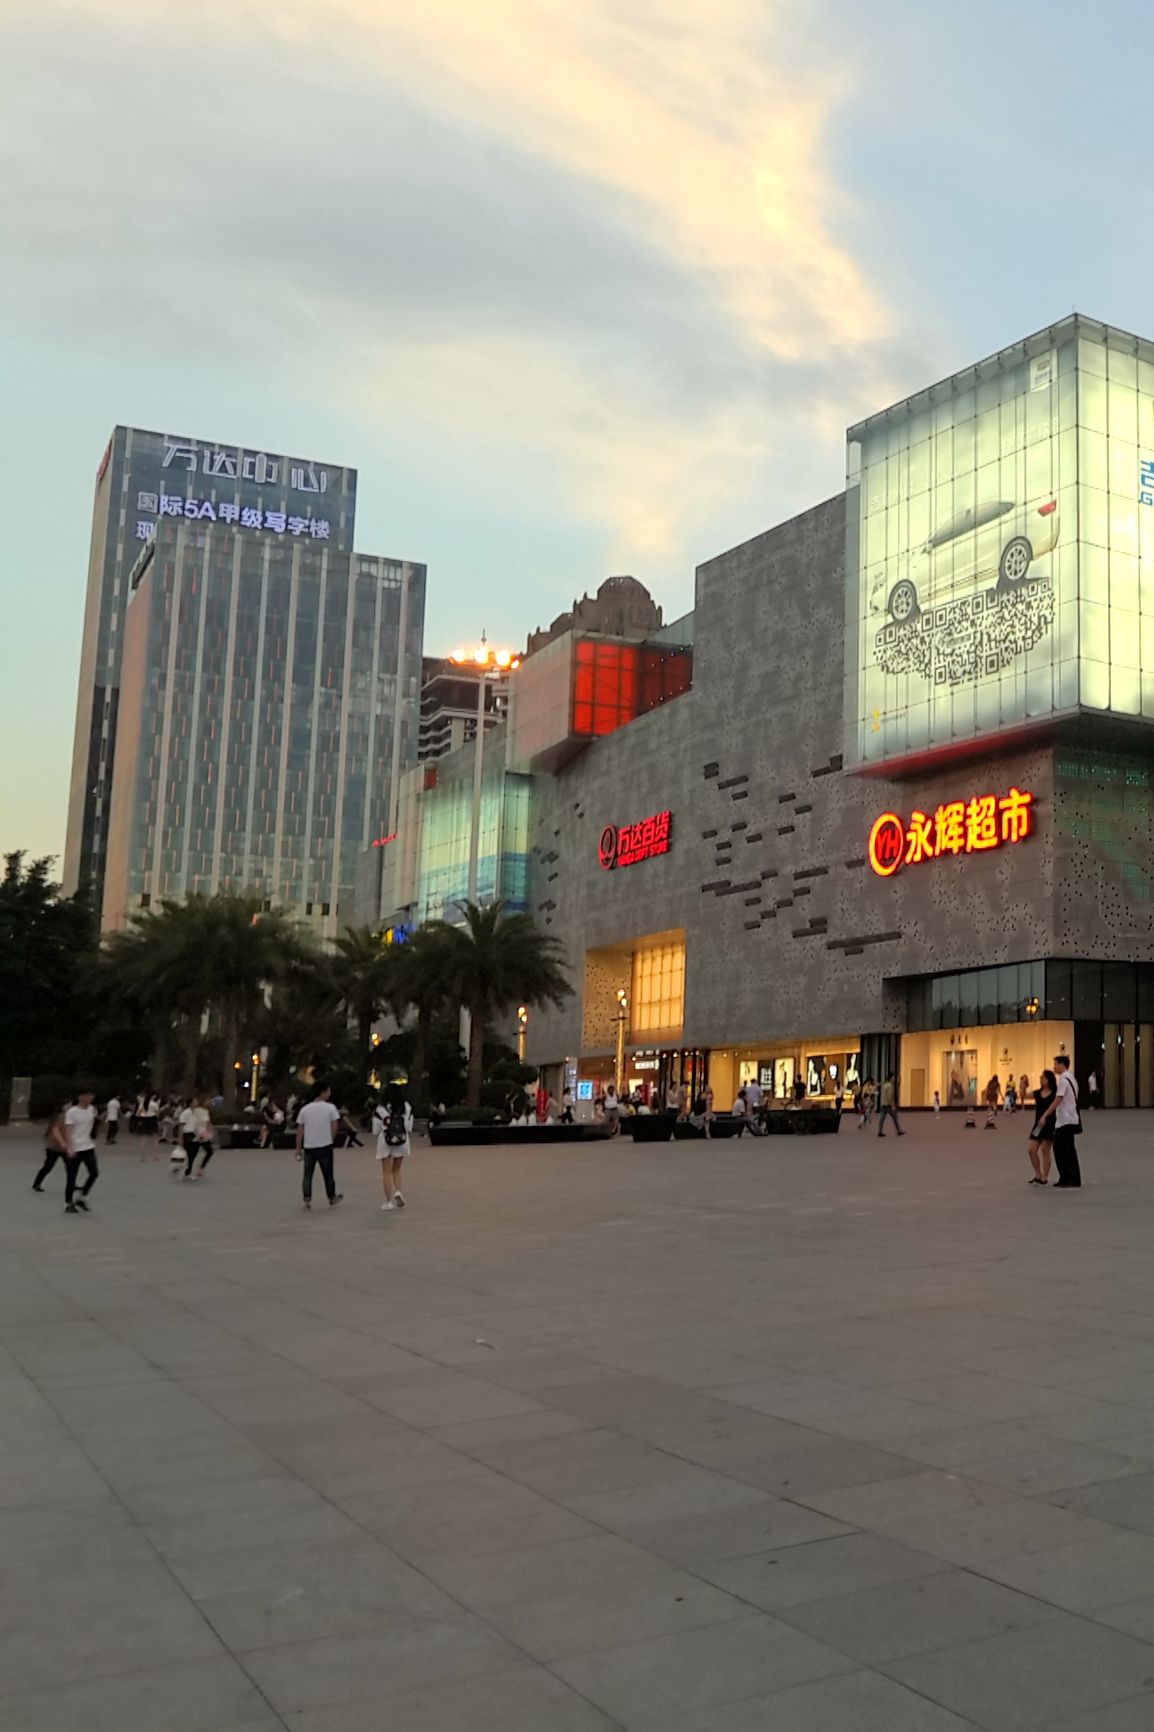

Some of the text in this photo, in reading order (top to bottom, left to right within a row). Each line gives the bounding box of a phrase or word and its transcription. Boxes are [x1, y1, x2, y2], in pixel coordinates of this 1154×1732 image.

[161, 440, 328, 494] 万达中心
[136, 490, 331, 540] 国际5A甲级写字楼
[617, 810, 671, 856] 万达百货
[903, 785, 1033, 866] 永辉超市
